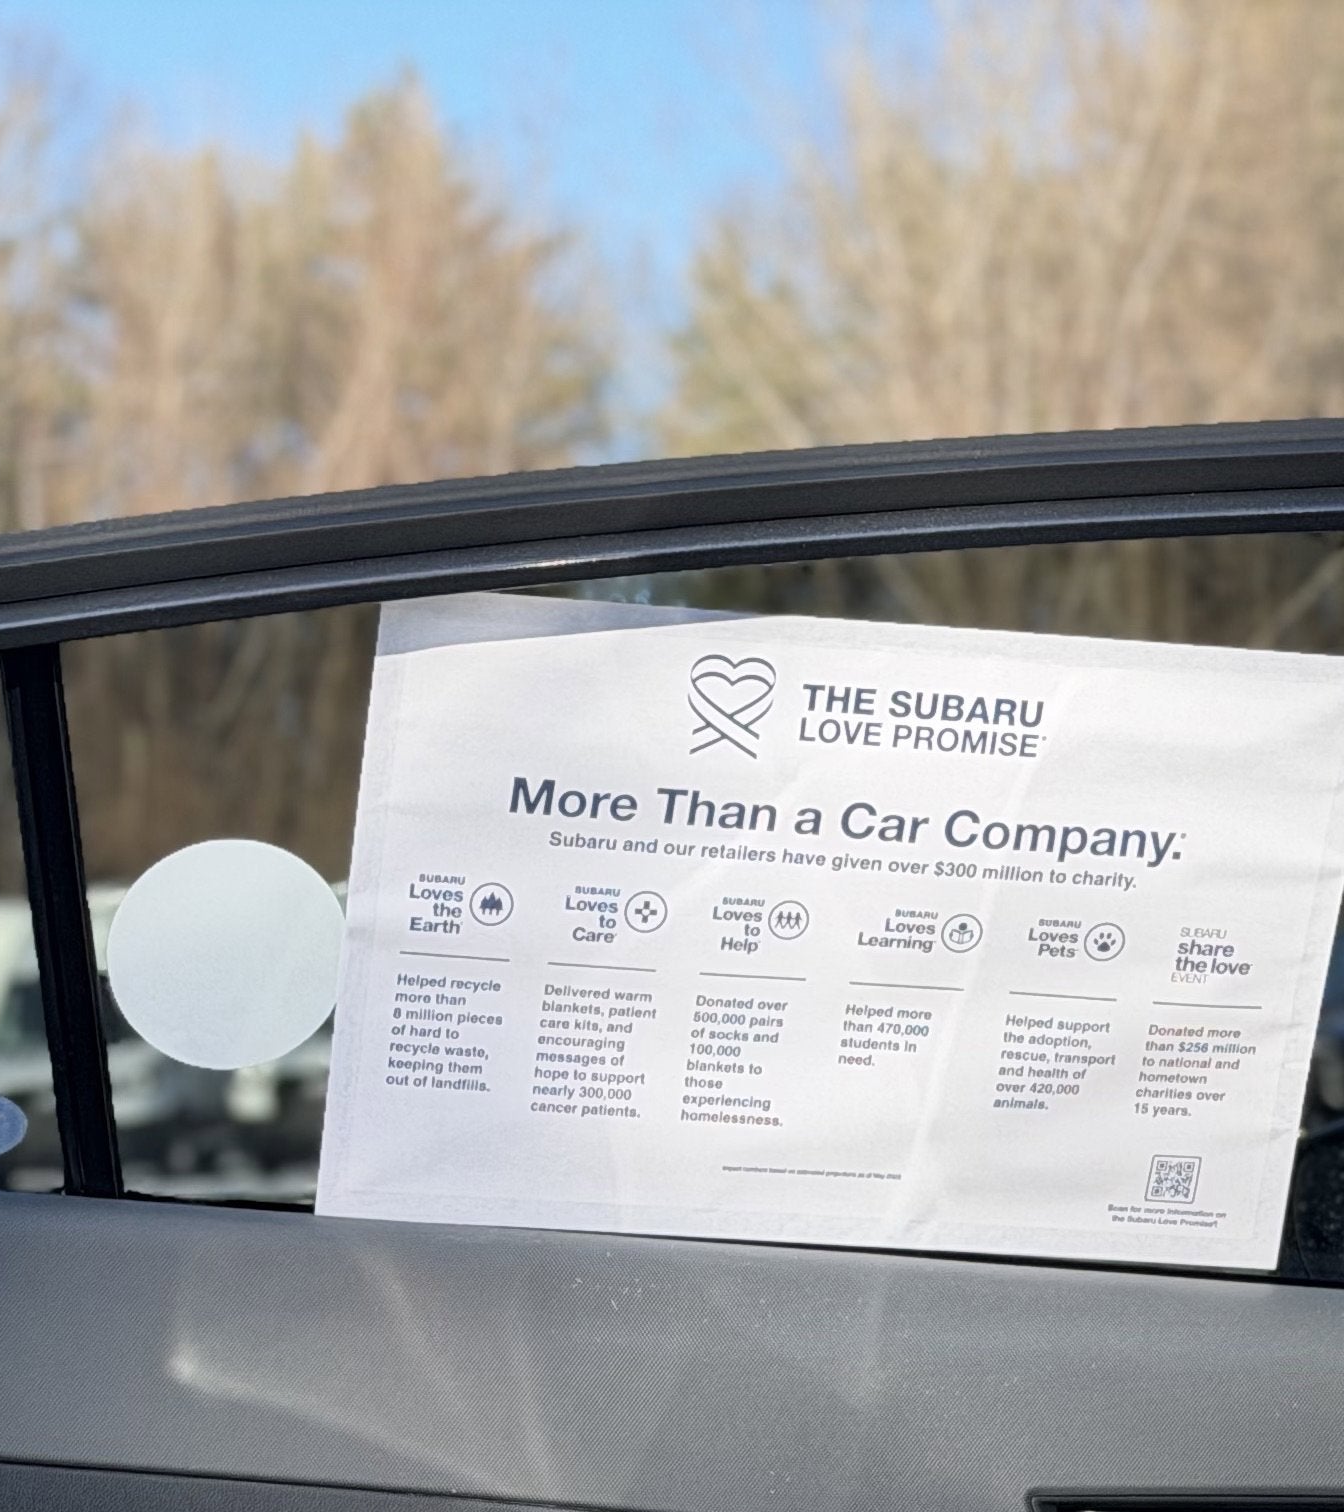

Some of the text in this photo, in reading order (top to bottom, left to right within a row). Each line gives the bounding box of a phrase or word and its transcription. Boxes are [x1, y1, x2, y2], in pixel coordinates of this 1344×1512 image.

[802, 683, 1045, 728] THE SUBARU
[799, 717, 883, 747] LOVE
[509, 776, 1182, 866] More Than a Car Company.
[548, 830, 1137, 892] Subaru and our retailers have given over $300 million to charity.
[418, 873, 466, 886] SUBARU
[409, 884, 464, 903] Loves
[574, 885, 621, 898] SUBARU
[432, 902, 463, 919] the
[565, 896, 619, 914] Loves
[721, 896, 766, 908] SUBARU
[598, 914, 617, 930] to
[712, 905, 763, 923] Loves
[894, 908, 939, 920] SUBARU
[409, 916, 461, 935] Earth
[744, 923, 761, 937] to
[884, 918, 936, 936] Loves
[1038, 918, 1082, 929] SUBARU
[572, 926, 616, 944] Care
[857, 931, 934, 953] Learning
[1027, 927, 1079, 944] Loves
[1179, 926, 1228, 940] SUBARU
[720, 936, 759, 955] Help
[1037, 943, 1075, 959] Pets
[1177, 939, 1235, 958] share
[1175, 956, 1250, 976] the love
[396, 973, 502, 994] Helped recycle
[1170, 971, 1208, 984] EVENT
[394, 992, 467, 1006] more than
[544, 983, 653, 1003] Delivered warm
[541, 1000, 657, 1020] blankets, patient
[695, 994, 789, 1012] Donated over
[845, 1003, 933, 1021] Helped more
[392, 1007, 503, 1026] 8 million pieces
[693, 1010, 784, 1029] 500,000 pairs
[1005, 1014, 1111, 1034] Helped support
[391, 1024, 460, 1040] of hard to
[539, 1018, 633, 1034] care kits, and
[843, 1020, 930, 1038] than 470,000
[1148, 1023, 1242, 1039] Donated more
[537, 1035, 626, 1053] encouraging
[690, 1027, 780, 1044] of socks and
[840, 1037, 900, 1052] students
[1003, 1031, 1092, 1050] the adoption,
[389, 1042, 489, 1061] recycle waste,
[689, 1042, 742, 1058] 100,000
[1145, 1040, 1257, 1055] than $256 million
[387, 1056, 483, 1075] keeping them
[535, 1052, 625, 1068] messages of
[686, 1058, 763, 1076] blankets to
[837, 1054, 875, 1066] need.
[1000, 1049, 1116, 1067] rescue, transport
[1142, 1056, 1241, 1070] to national and
[534, 1065, 645, 1086] hope to support
[998, 1065, 1087, 1080] and health of
[1138, 1071, 1208, 1085] hometown
[385, 1074, 491, 1093] out of landfills.
[684, 1075, 724, 1090] those
[995, 1082, 1080, 1096] over 420,000
[532, 1084, 632, 1101] nearly 300,000
[1135, 1086, 1226, 1102] charities over
[530, 1101, 641, 1119] cancer patients.
[682, 1094, 772, 1112] experiencing
[992, 1096, 1049, 1110] animals.
[1134, 1102, 1192, 1118] 15 years.
[680, 1108, 783, 1127] homelessness.
